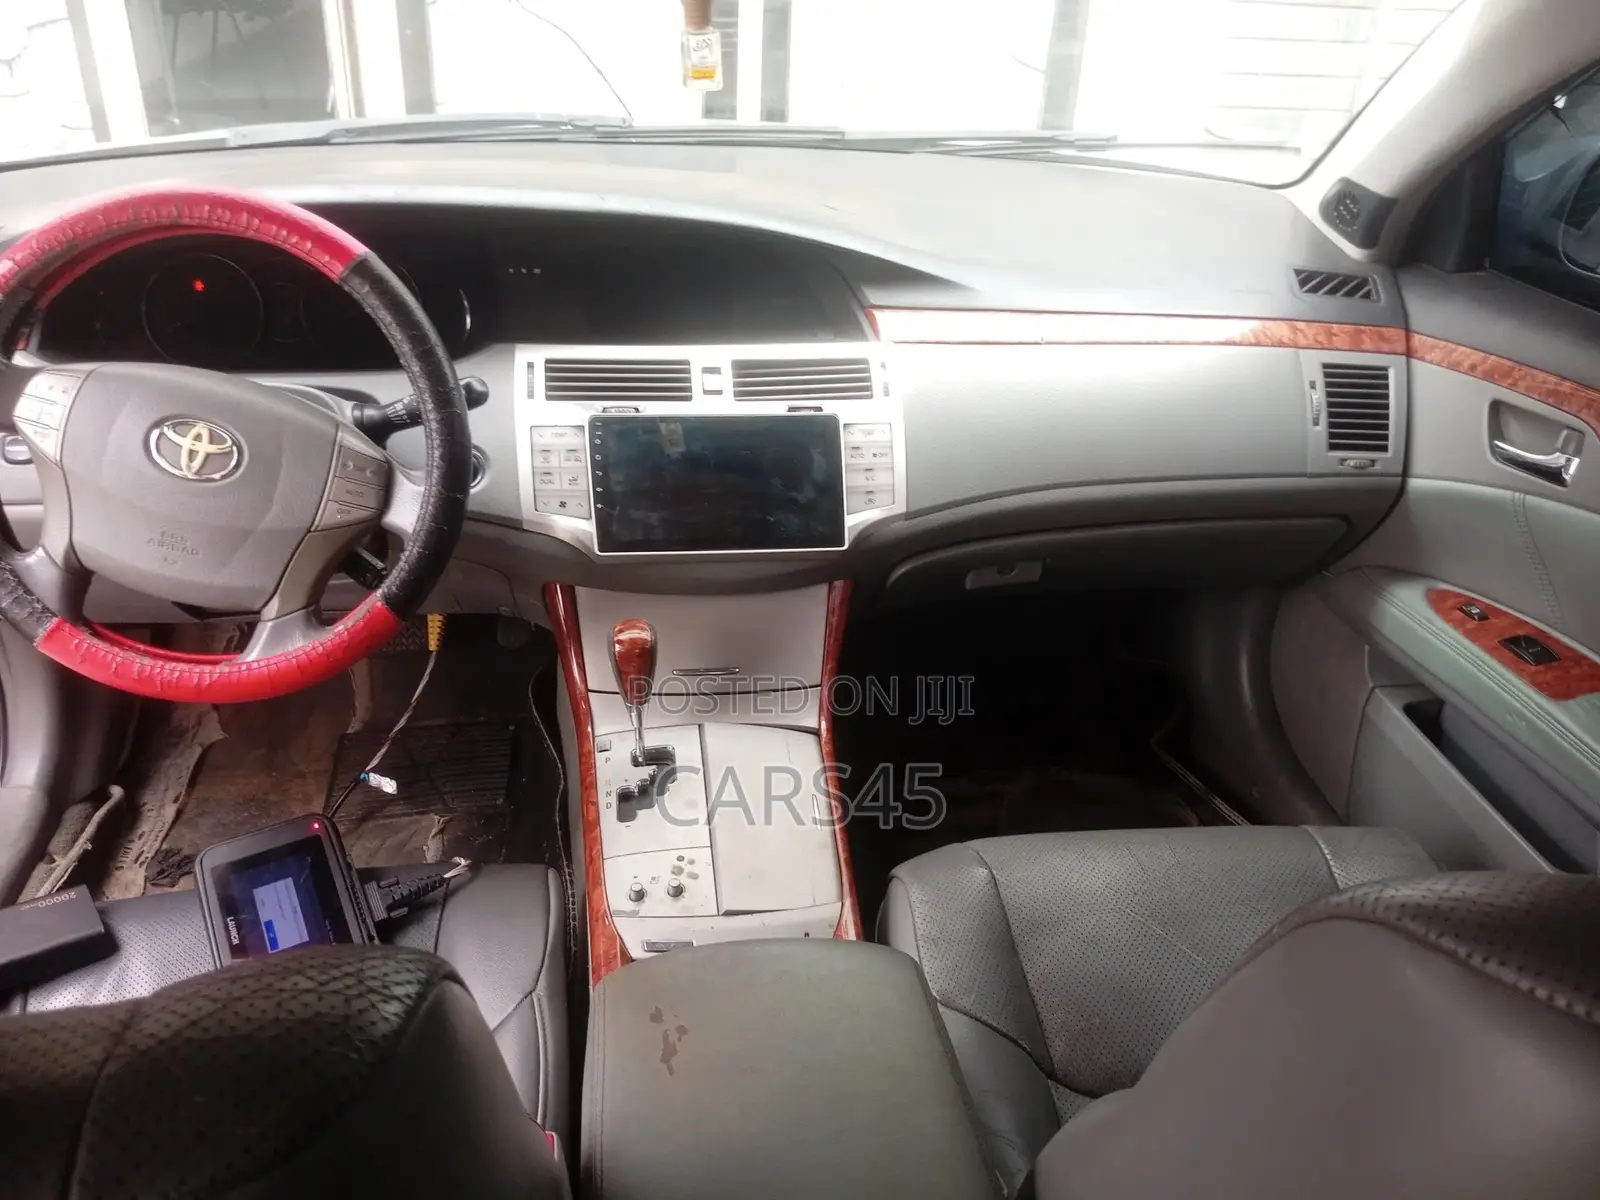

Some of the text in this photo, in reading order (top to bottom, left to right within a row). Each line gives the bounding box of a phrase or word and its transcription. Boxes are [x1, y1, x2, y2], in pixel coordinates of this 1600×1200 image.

[605, 790, 612, 798] N
[606, 801, 612, 809] D
[226, 916, 240, 946] LAUNCH
